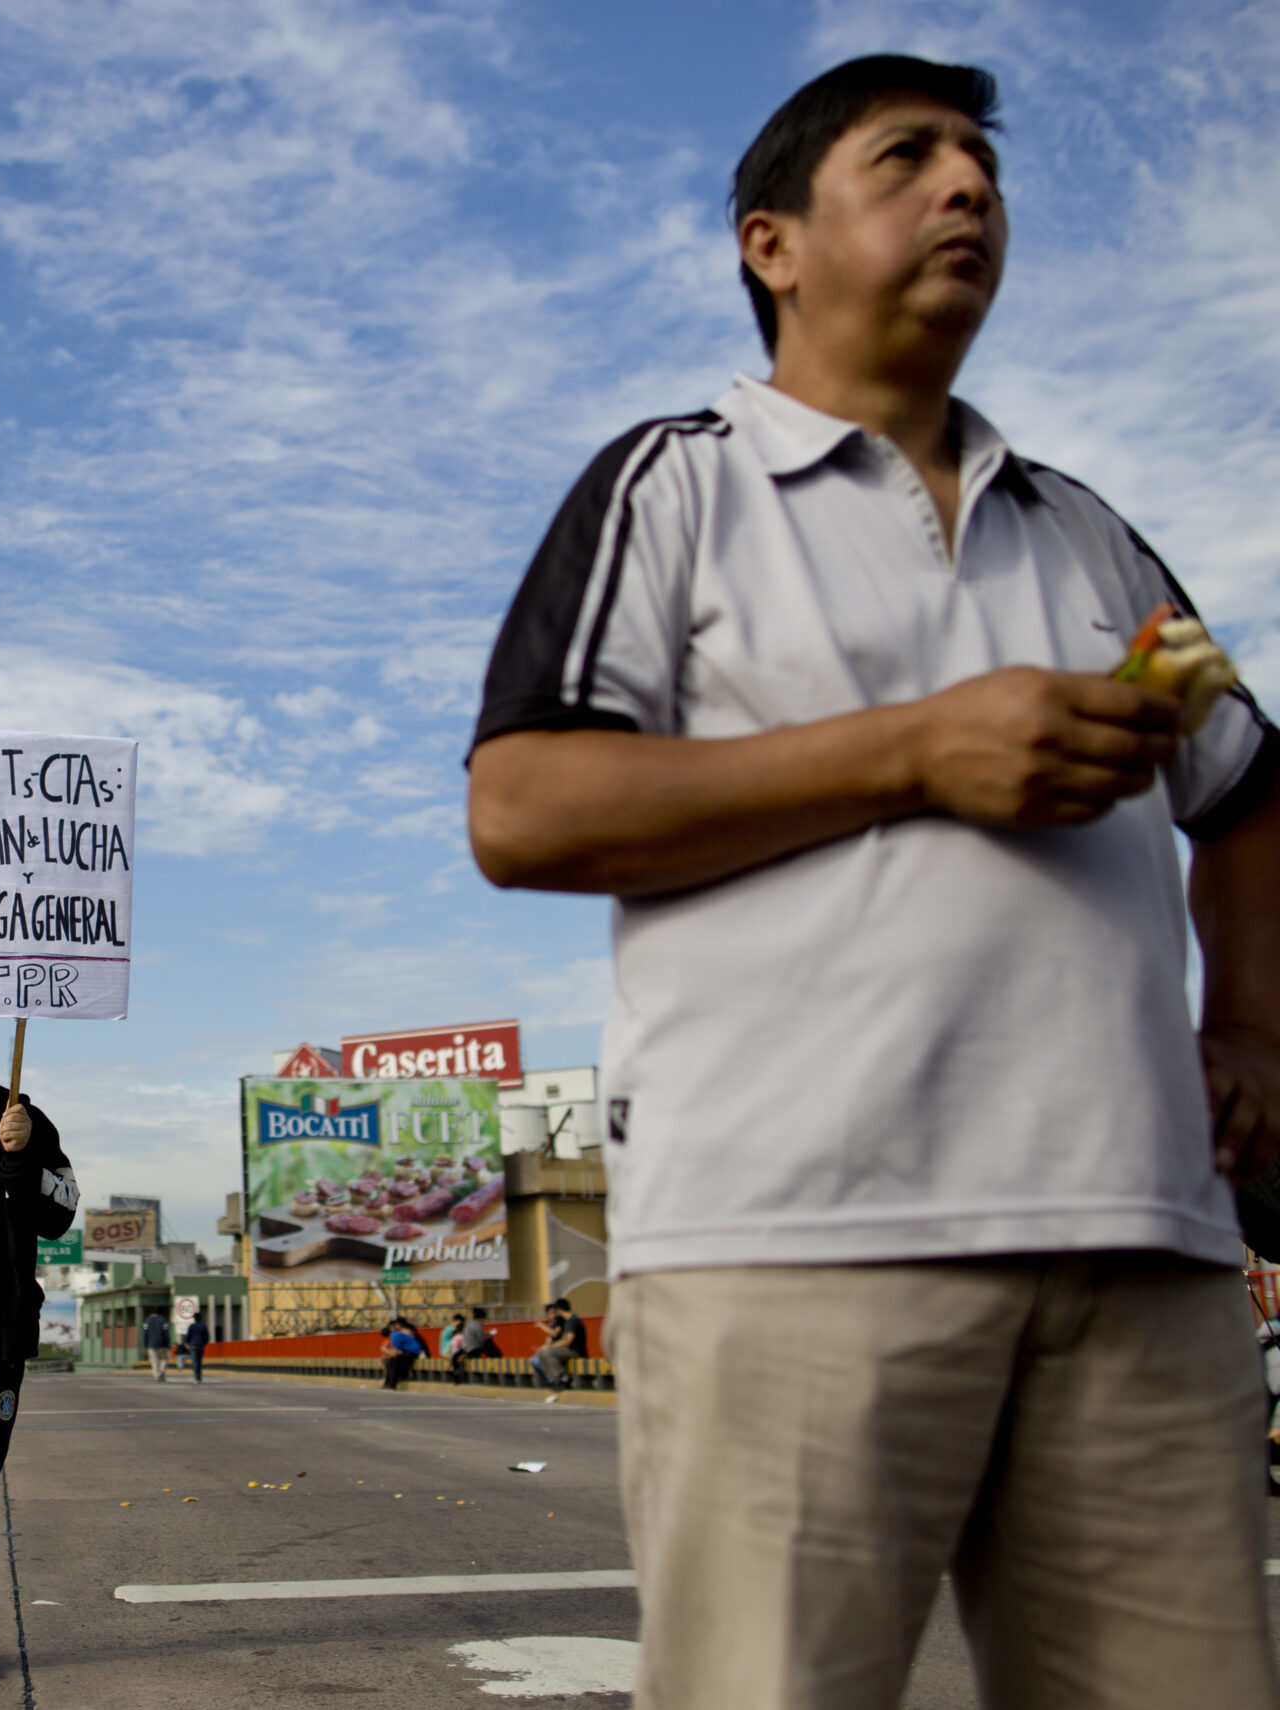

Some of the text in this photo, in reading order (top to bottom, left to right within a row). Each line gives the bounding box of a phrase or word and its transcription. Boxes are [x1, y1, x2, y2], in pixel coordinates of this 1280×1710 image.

[42, 816, 130, 872] LUCHA
[31, 894, 126, 947] GENERAL
[351, 1034, 507, 1078] Caserita
[387, 1111, 489, 1145] FUET
